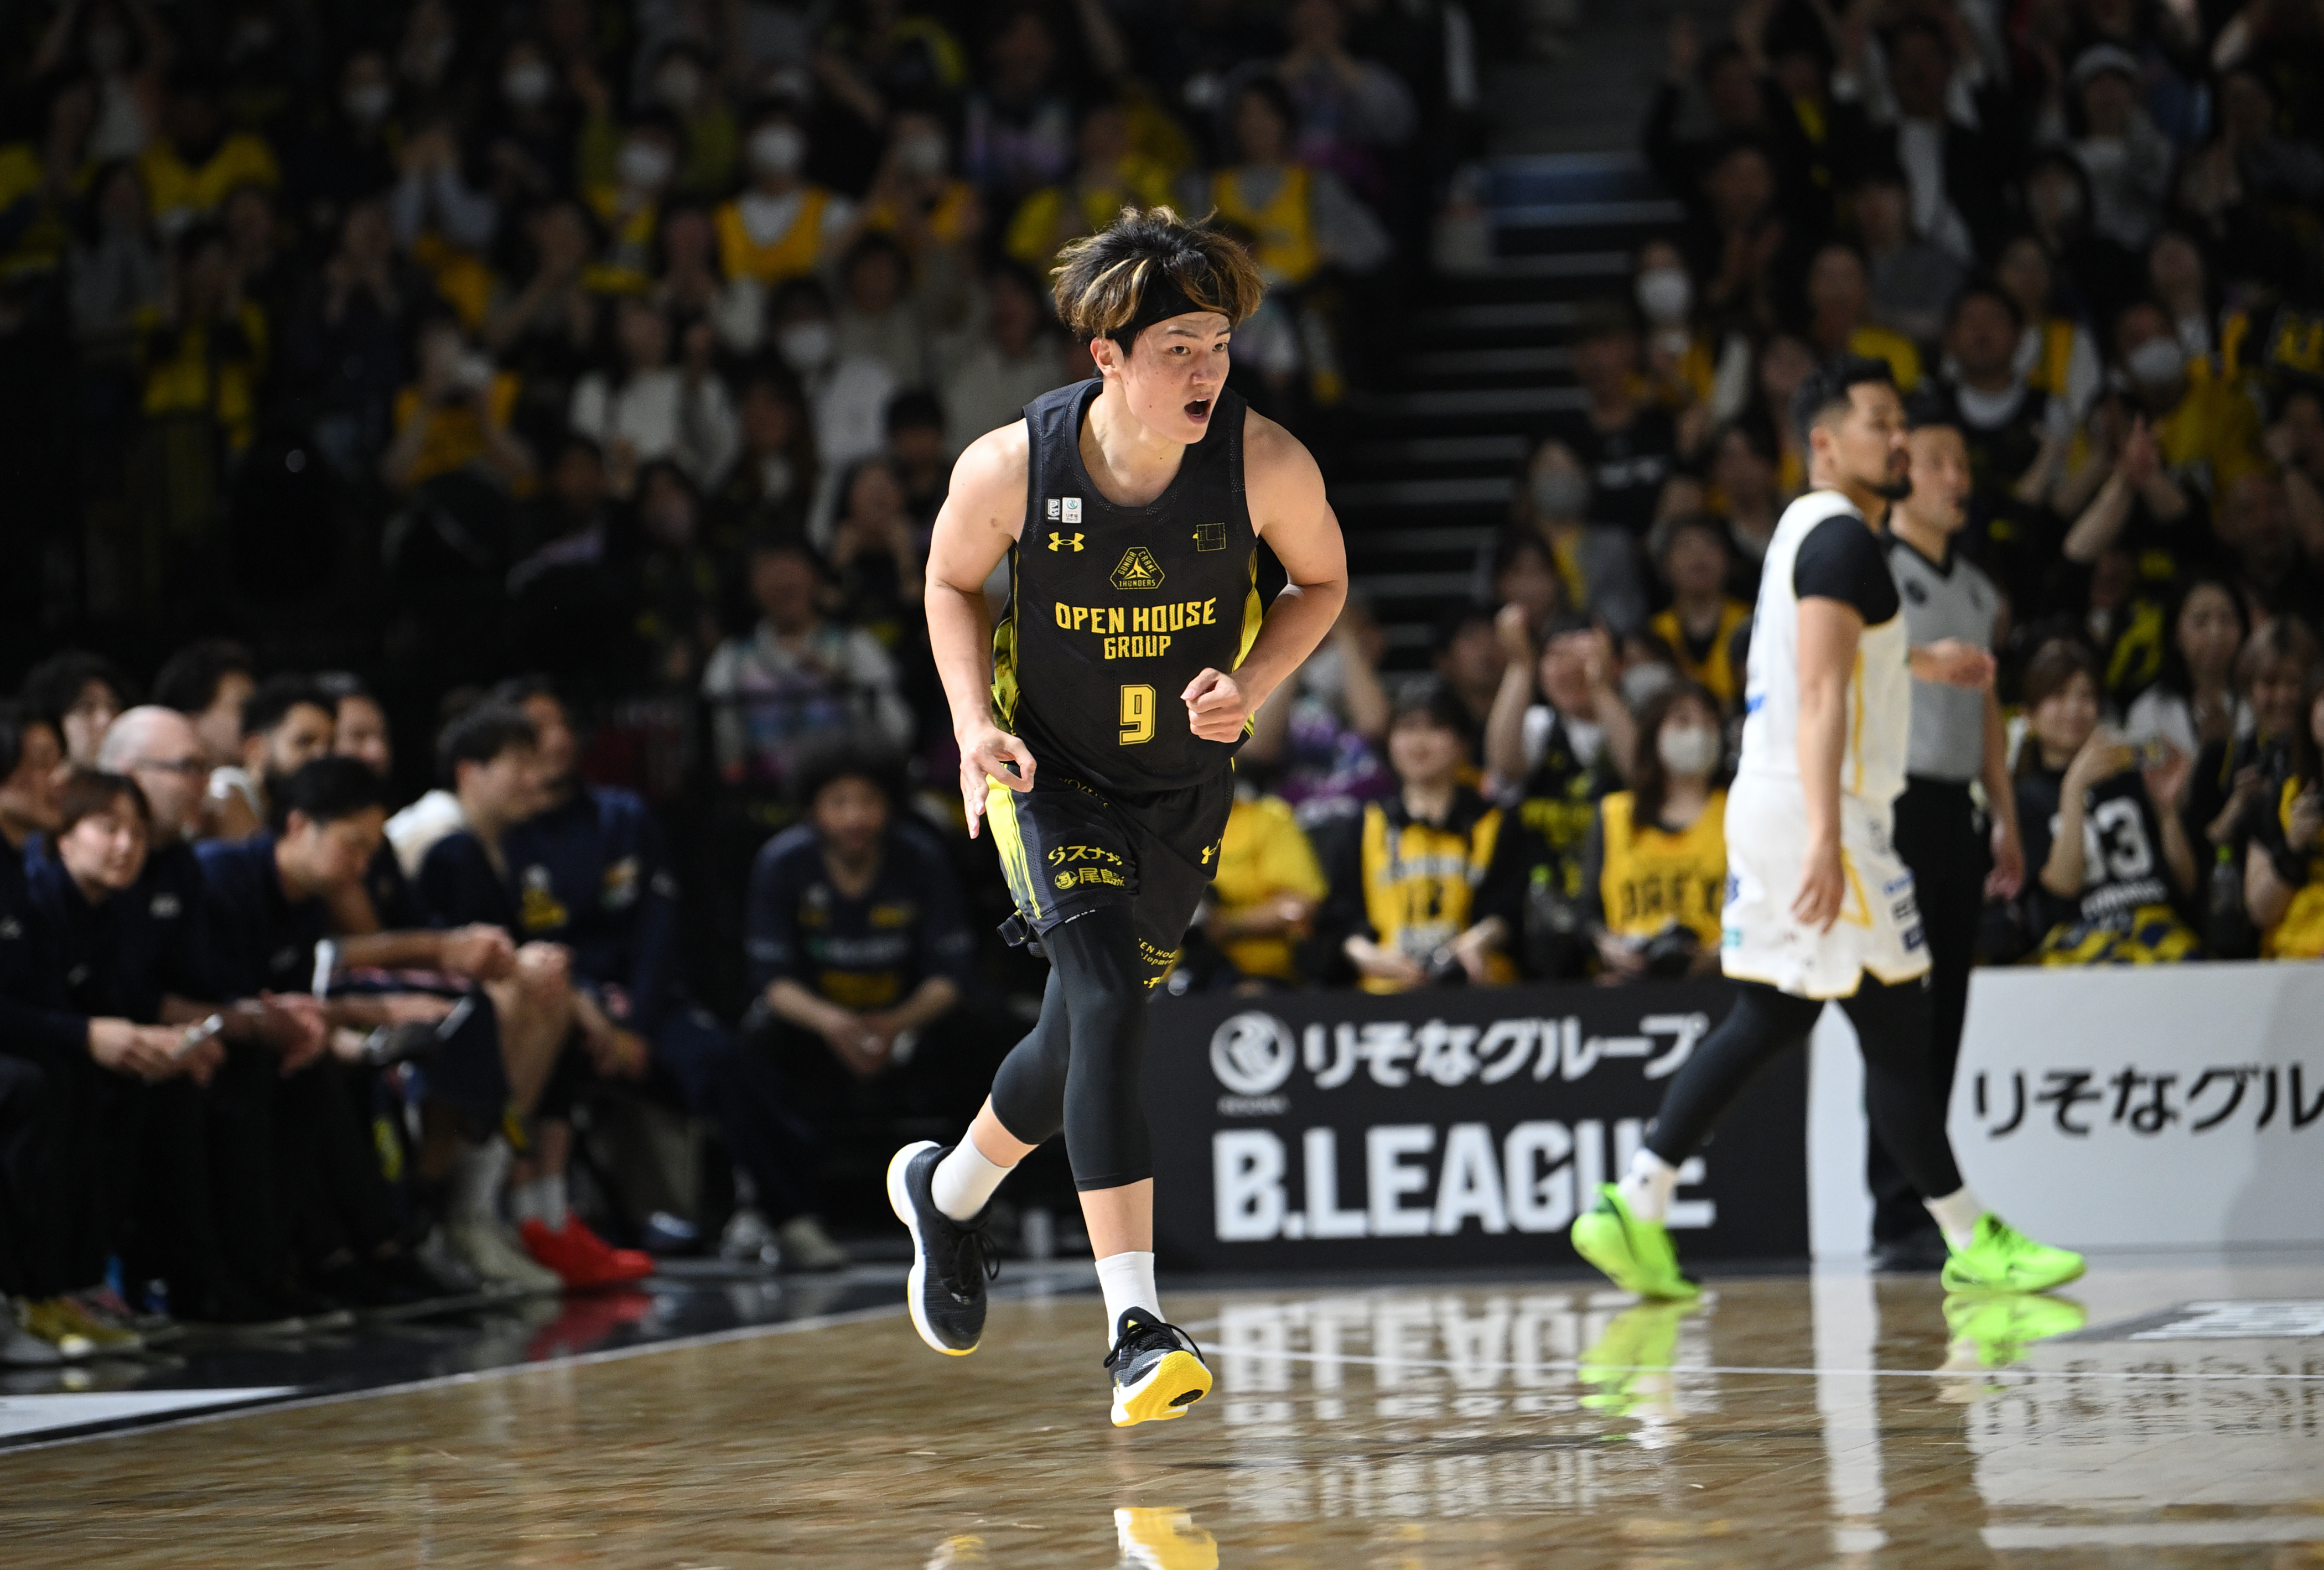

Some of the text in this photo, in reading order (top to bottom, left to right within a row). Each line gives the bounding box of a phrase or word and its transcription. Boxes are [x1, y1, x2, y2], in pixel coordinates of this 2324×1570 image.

[1118, 551, 1157, 575] GUNMA CRANE
[1055, 597, 1216, 634] OPEN HOUSE
[1103, 635, 1171, 660] GROUP
[1119, 684, 1156, 746] 9
[1303, 1011, 1709, 1089] りそなグループ
[1973, 1062, 2324, 1137] りそなグル
